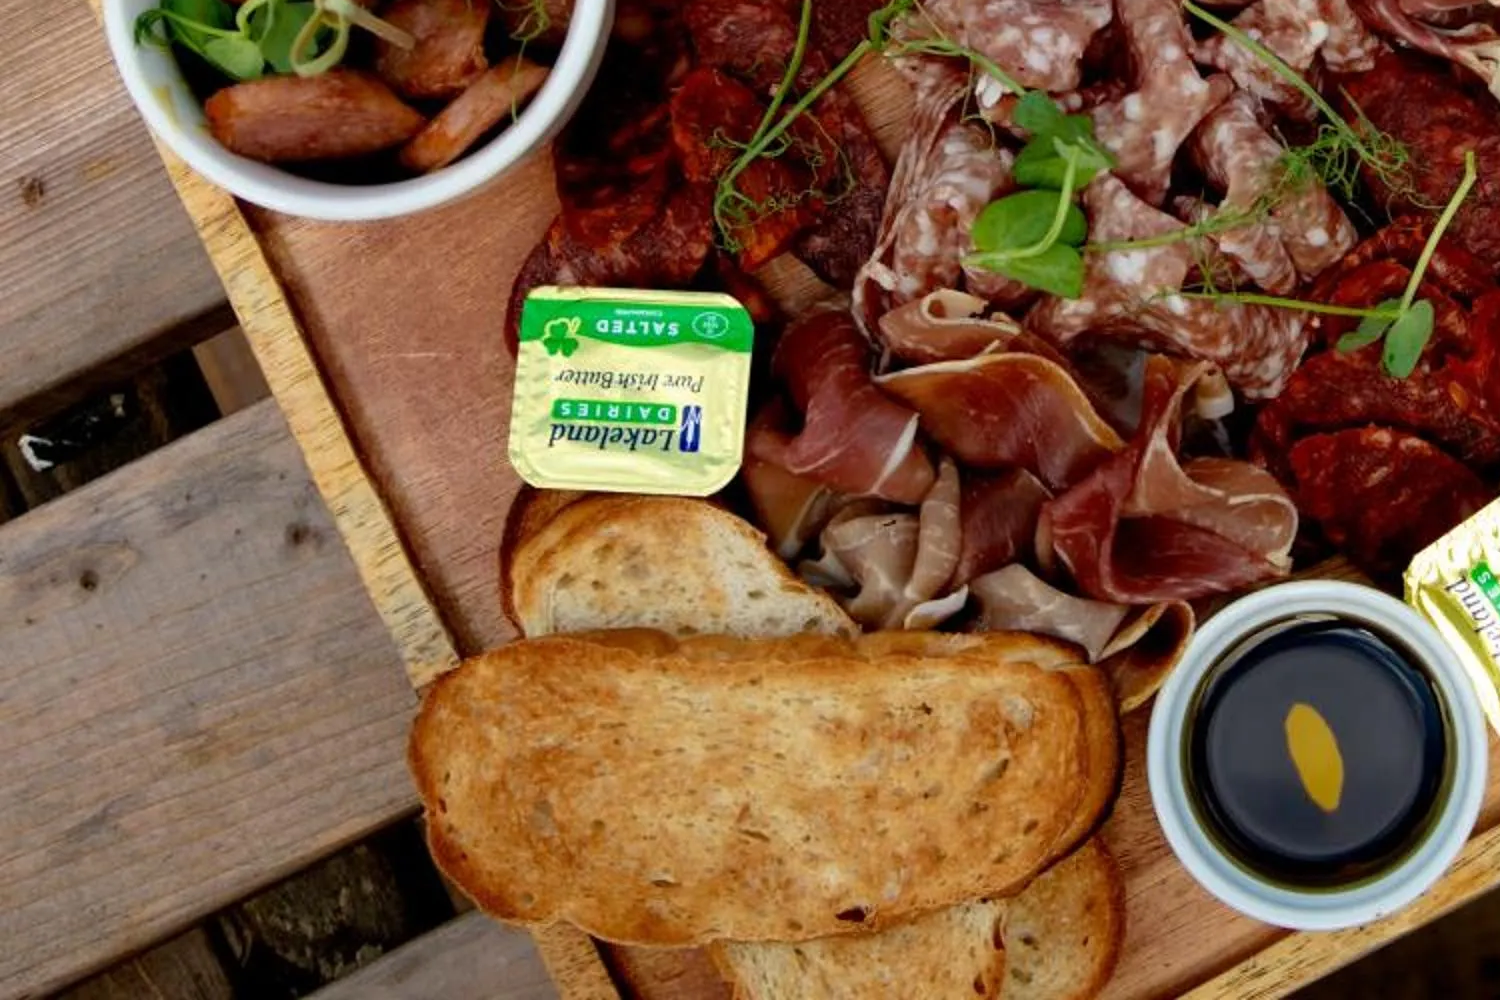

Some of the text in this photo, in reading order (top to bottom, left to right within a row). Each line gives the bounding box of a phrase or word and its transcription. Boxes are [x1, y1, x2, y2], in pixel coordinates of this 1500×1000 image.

[595, 319, 679, 335] SALTED
[554, 368, 613, 388] Butter
[617, 372, 658, 390] Irish
[558, 401, 670, 419] DAIRIES
[547, 422, 675, 452] Lakeland
